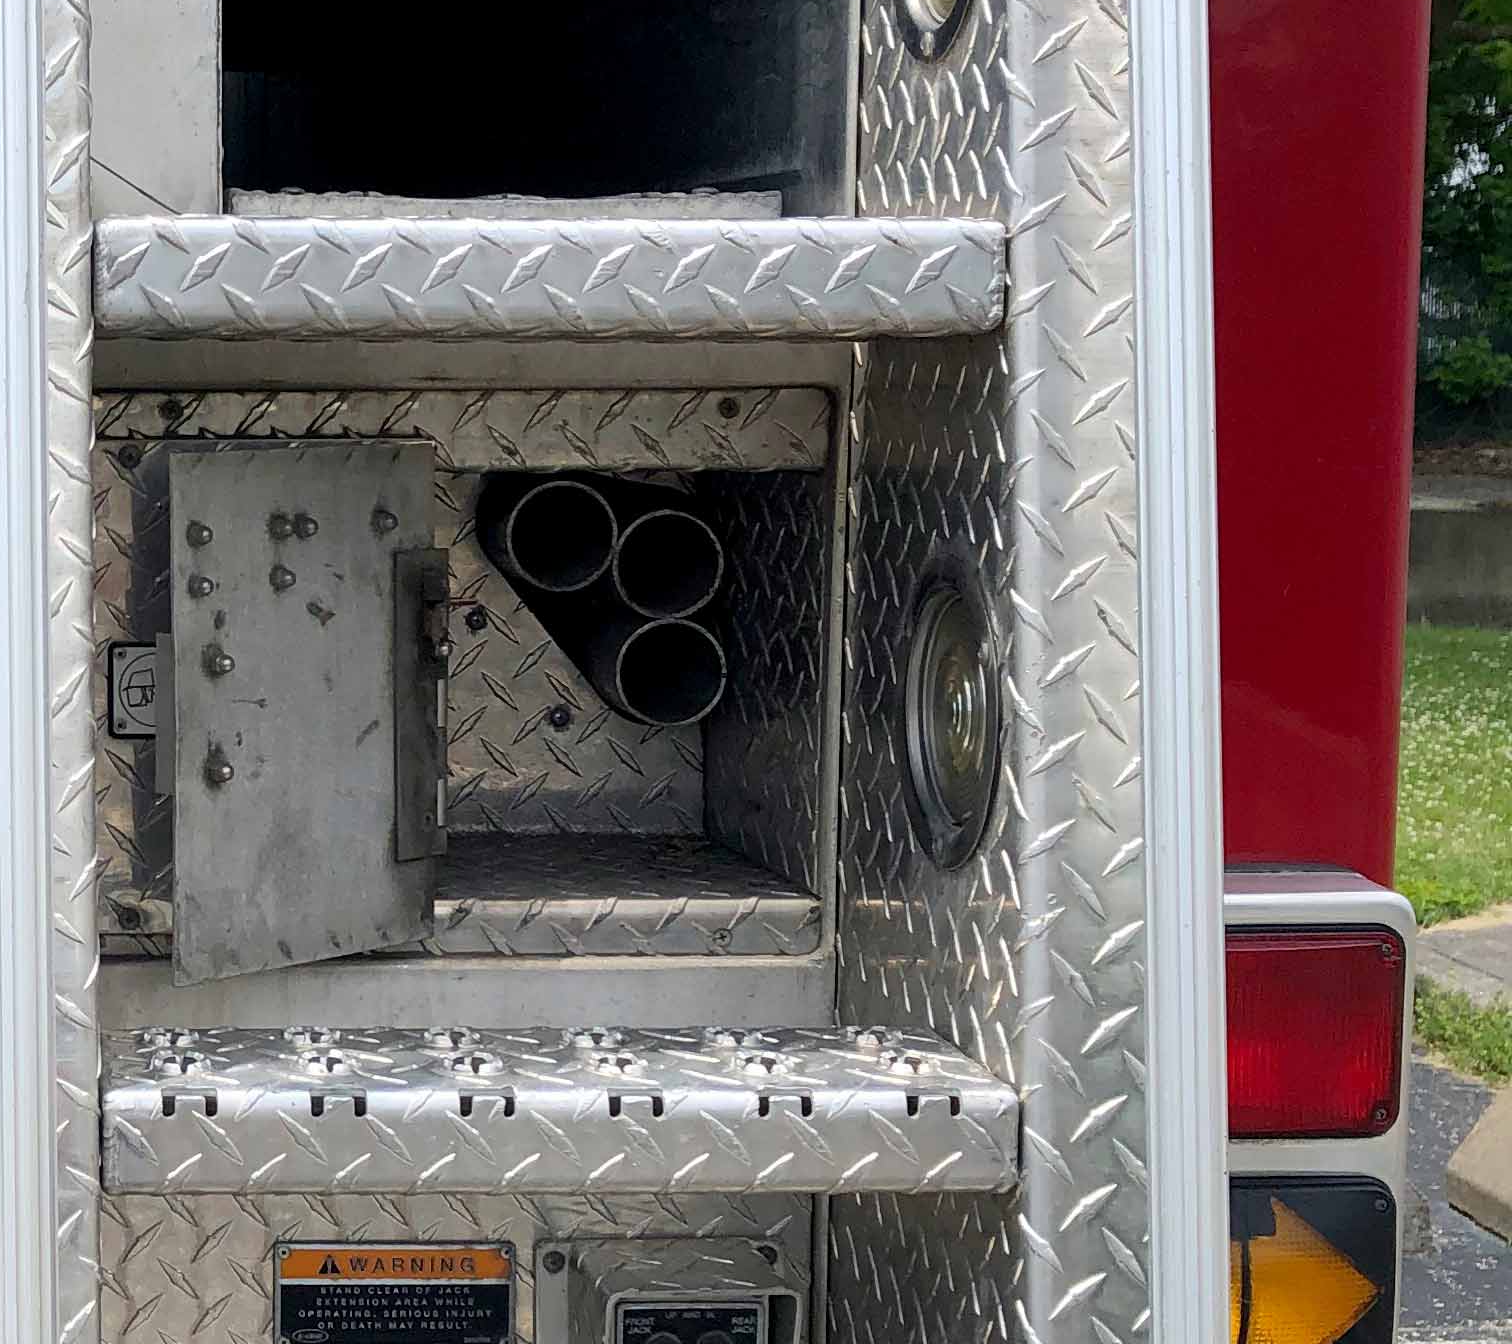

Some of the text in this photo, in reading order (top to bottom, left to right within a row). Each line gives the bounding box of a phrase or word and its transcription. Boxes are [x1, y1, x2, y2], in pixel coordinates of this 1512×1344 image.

[350, 1257, 476, 1273] WARNING
[320, 1287, 470, 1295] STAND CLEAR OF JACK
[316, 1298, 475, 1306] EXTENSION AREA WHILE
[384, 1310, 438, 1318] SERIOUS
[446, 1310, 492, 1318] INJURY
[625, 1317, 655, 1326] FRONT
[731, 1316, 756, 1325] REAR
[318, 1321, 334, 1330] OR
[341, 1321, 382, 1330] DEATH
[389, 1321, 413, 1330] MAY
[731, 1325, 755, 1334] JACK
[627, 1327, 652, 1335] JACK
